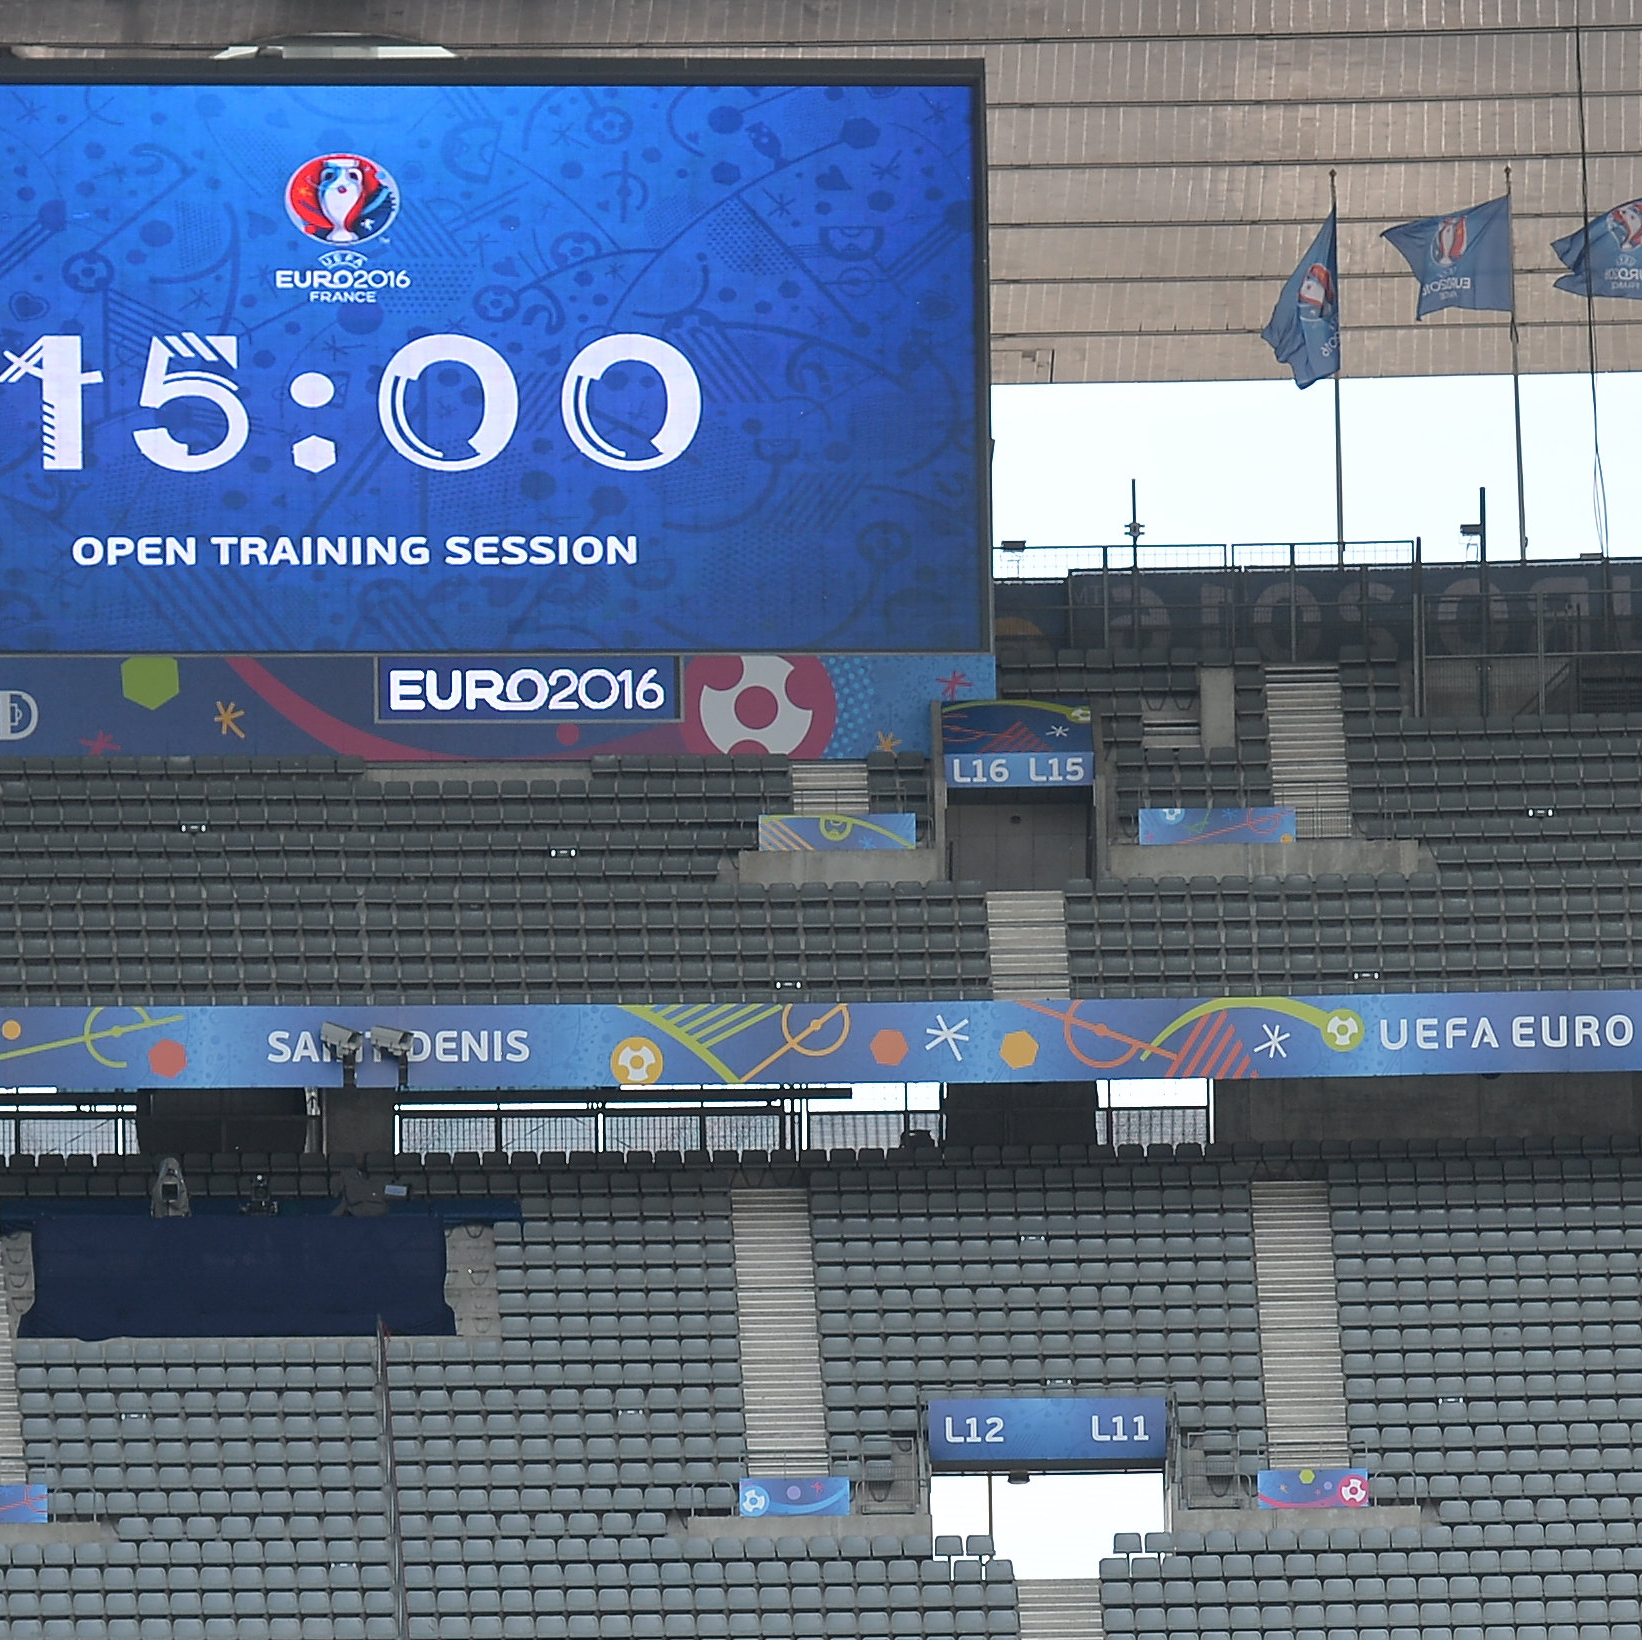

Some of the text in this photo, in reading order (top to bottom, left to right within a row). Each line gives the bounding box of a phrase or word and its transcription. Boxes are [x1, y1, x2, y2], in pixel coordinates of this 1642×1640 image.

[276, 270, 410, 288] EURO2016
[310, 291, 376, 302] FRANCE
[73, 536, 636, 565] OPEN TRAINING SESSION
[390, 669, 664, 710] EURO2016
[954, 758, 1084, 782] L16 L15
[1381, 1018, 1499, 1050] UEFA
[1513, 1015, 1633, 1047] EURO
[946, 1416, 1148, 1442] L12 L11
